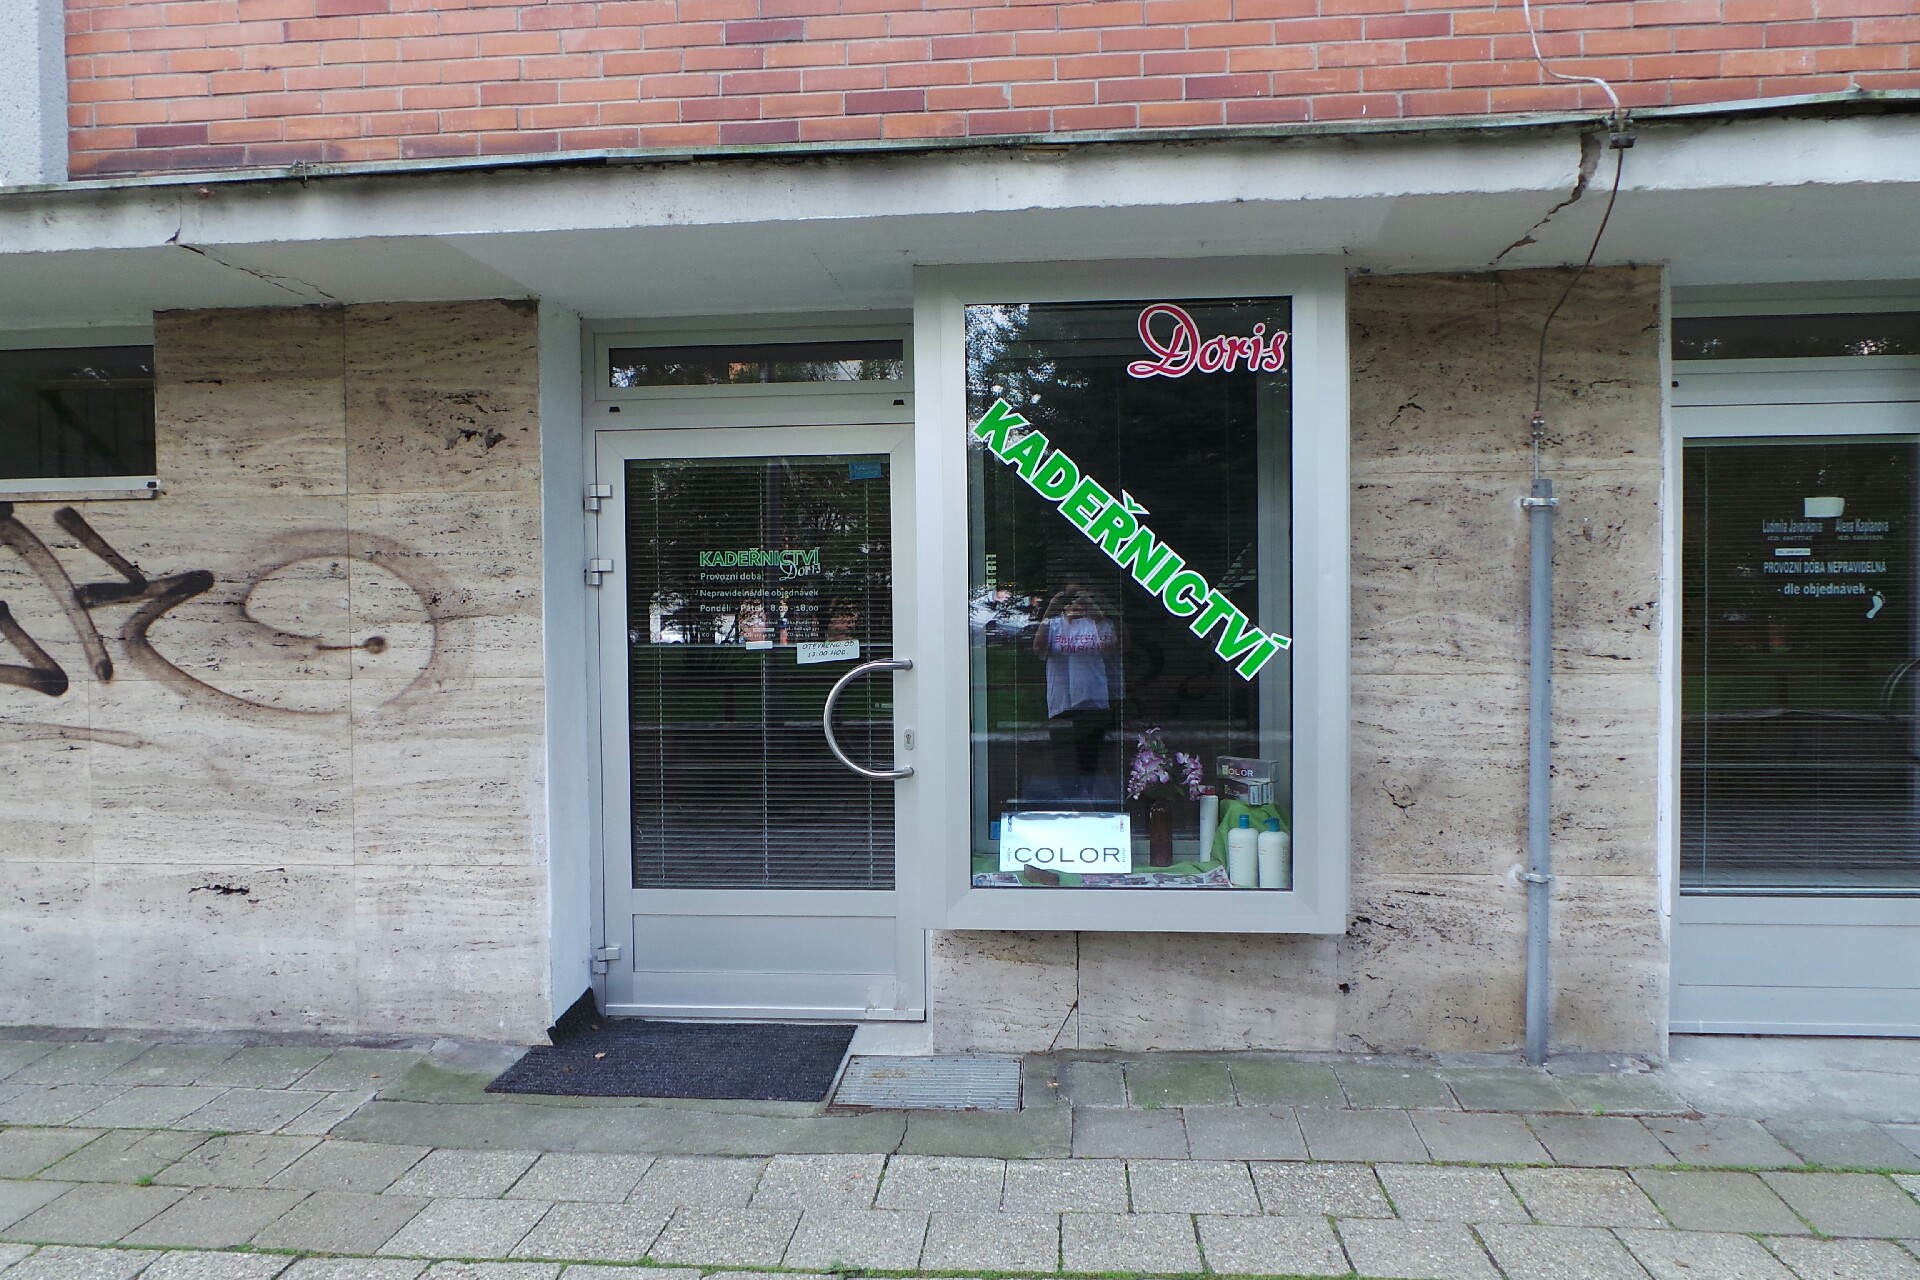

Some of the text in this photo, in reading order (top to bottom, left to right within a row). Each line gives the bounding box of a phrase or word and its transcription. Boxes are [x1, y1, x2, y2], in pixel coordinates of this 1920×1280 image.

[1126, 303, 1288, 378] Doris
[1762, 519, 1788, 533] Ludmila
[1835, 518, 1854, 533] Alena
[972, 397, 1292, 682] KADEŘNICTVÍ
[699, 546, 820, 567] KADEŘNICTVÍ
[779, 560, 821, 581] Doris
[1804, 562, 1825, 574] DOBA
[700, 571, 738, 581] Provozní
[699, 587, 819, 600] Nepravidelná/dle objednávek
[1784, 582, 1800, 595] dle
[1803, 582, 1866, 598] objednávek
[700, 603, 731, 613] Pondělí
[740, 603, 764, 612] Pátek
[1014, 847, 1120, 863] COLOR
